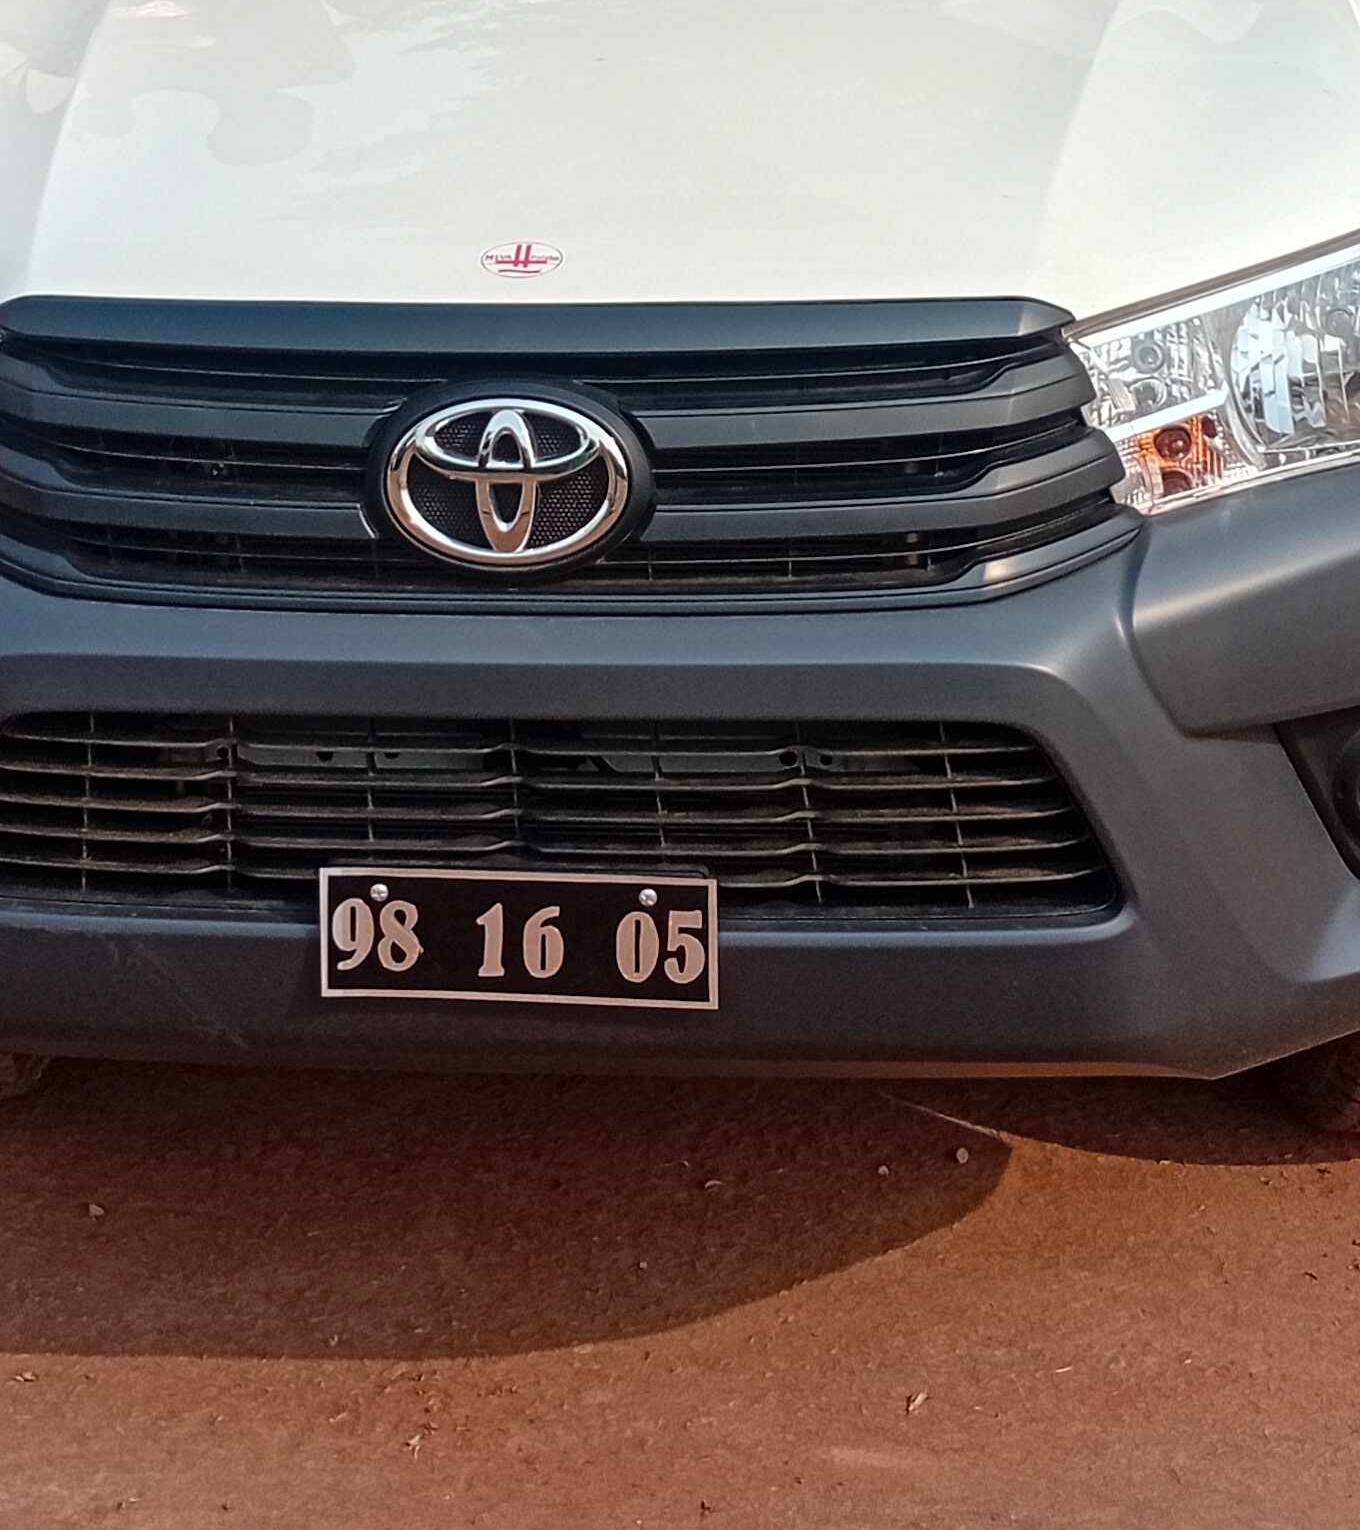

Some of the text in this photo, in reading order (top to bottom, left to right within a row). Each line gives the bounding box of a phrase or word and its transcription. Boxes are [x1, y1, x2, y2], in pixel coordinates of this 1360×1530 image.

[332, 897, 706, 984] 98 16 05
